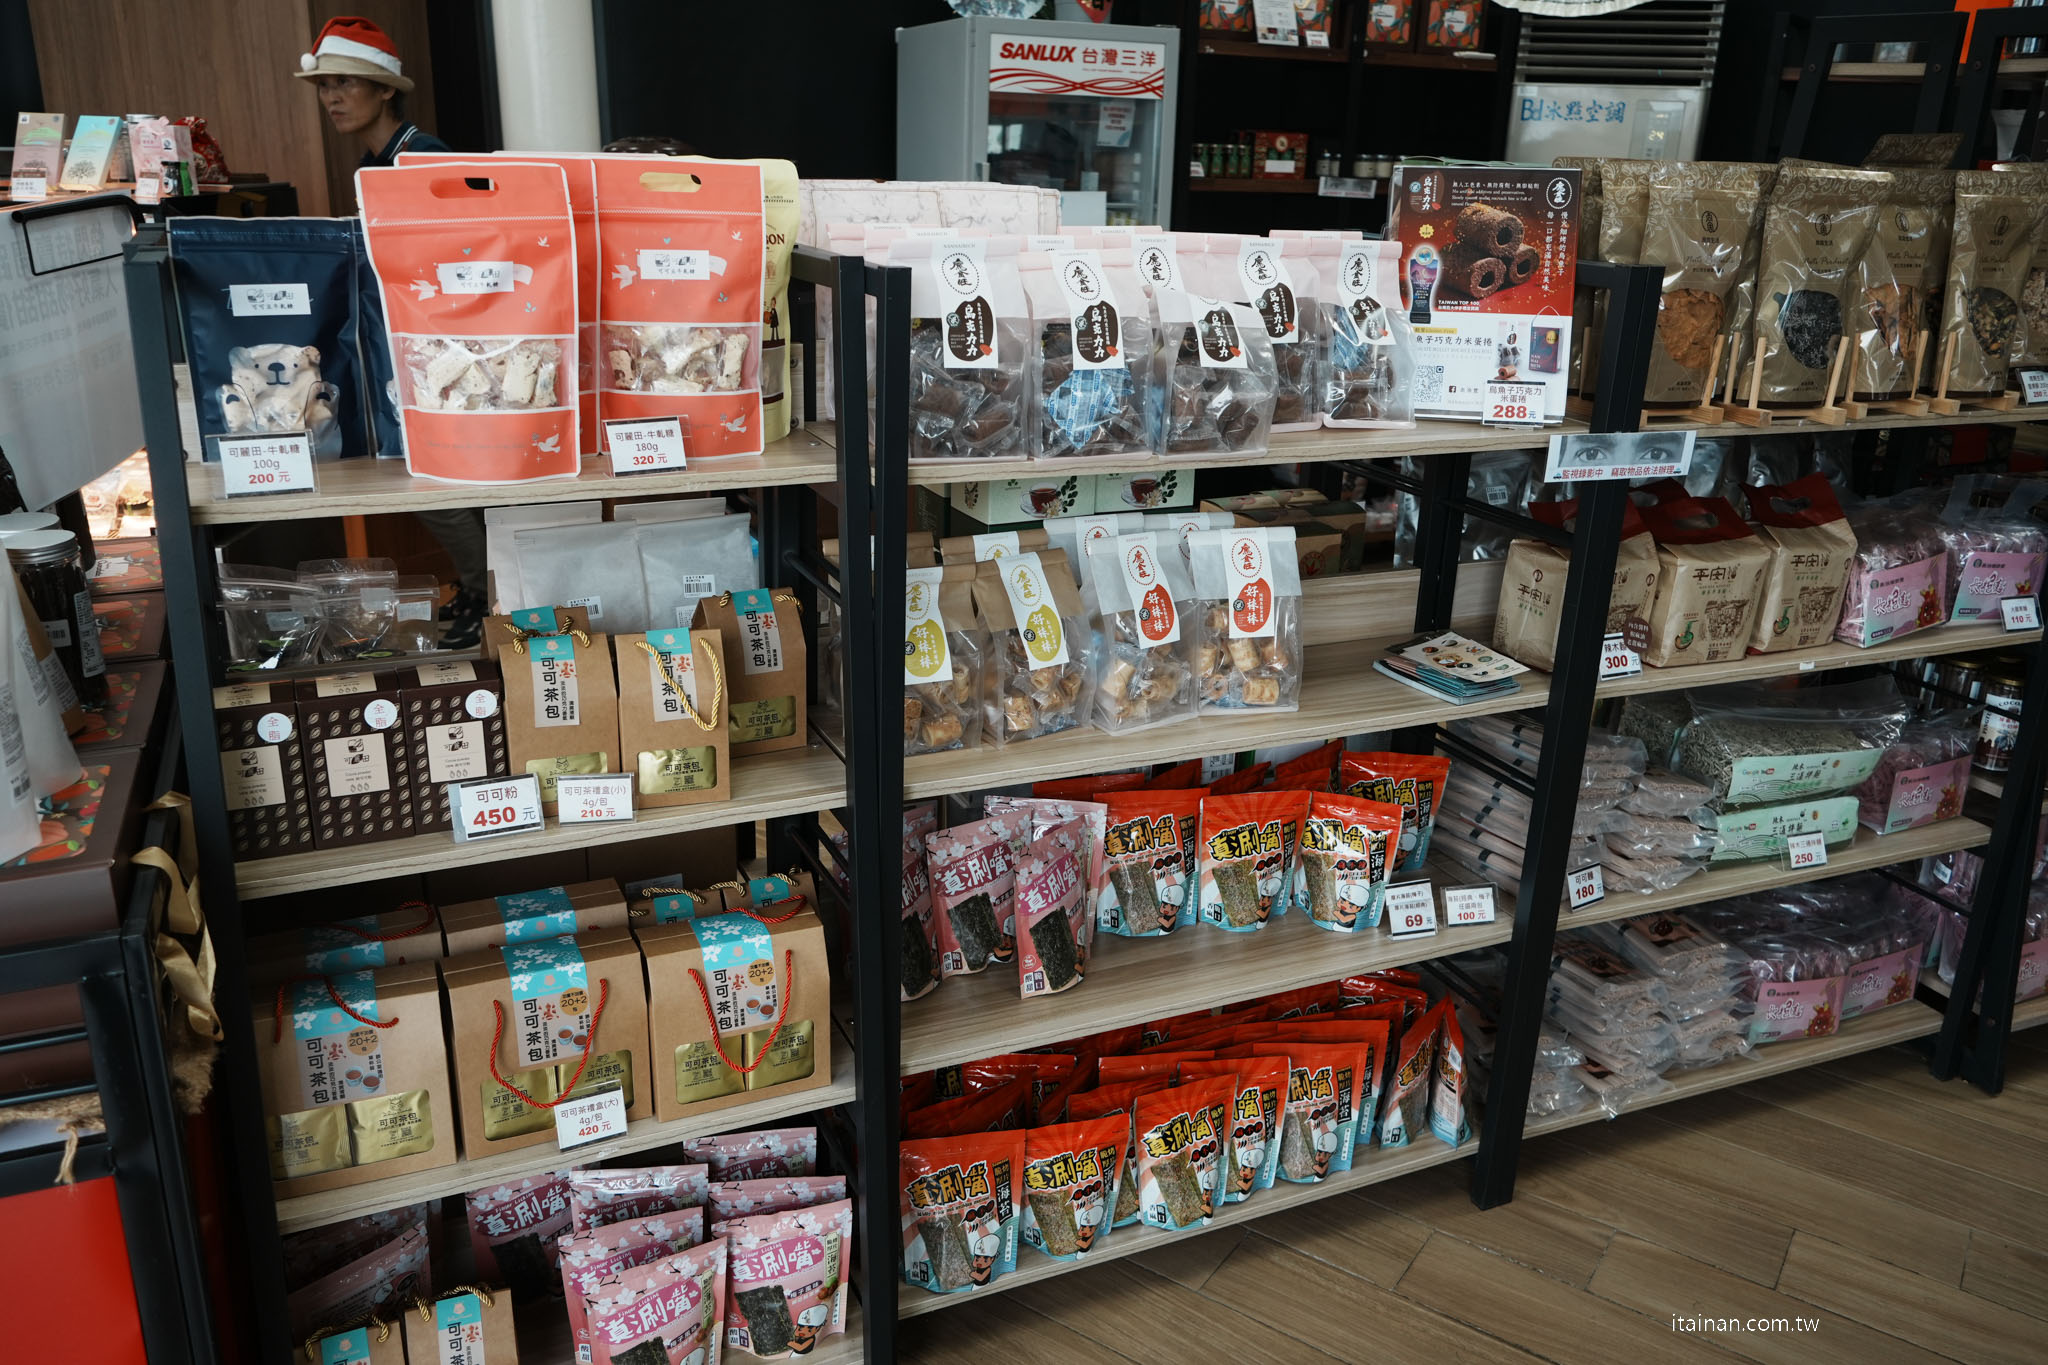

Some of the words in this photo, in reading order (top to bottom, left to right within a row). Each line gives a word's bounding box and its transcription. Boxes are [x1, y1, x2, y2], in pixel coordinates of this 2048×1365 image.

[1000, 42, 1076, 64] SANLUX
[1082, 48, 1156, 68] 台灣三洋
[1492, 405, 1528, 418] 288
[1528, 411, 1536, 419] 元
[636, 442, 658, 453] 180g
[253, 459, 280, 470] 100g
[633, 455, 654, 465] 320
[657, 453, 668, 464] 元
[248, 473, 275, 485] 200
[278, 471, 291, 483] 元
[1562, 468, 1603, 479] 監視錄影中
[1612, 466, 1674, 477] 竊取物品依法辦理
[1147, 593, 1164, 633] 好棒棒
[1244, 585, 1259, 625] 好棒棒
[2012, 616, 2024, 624] 110
[2026, 614, 2032, 622] 元
[744, 610, 766, 666] 可可茶包
[1031, 613, 1052, 653] 好棒棒
[912, 627, 933, 668] 好棒棒
[1605, 656, 1628, 668] 300
[1632, 656, 1639, 666] 元
[540, 658, 560, 718] 可可茶包
[659, 652, 678, 712] 可可茶包
[476, 693, 486, 716] 全脂
[374, 704, 387, 727] 全脂
[748, 714, 779, 724] 可可茶包
[268, 716, 280, 740] 全脂
[665, 762, 700, 772] 可可茶包
[476, 786, 518, 802] 可可粉
[564, 785, 626, 796] 可可茶禮盒(小)
[581, 809, 602, 818] 210
[606, 807, 616, 817] 元
[582, 798, 608, 808] 4g/包
[473, 806, 516, 827] 450
[523, 807, 536, 820] 元
[1105, 815, 1175, 856] 真涮嘴
[1212, 823, 1280, 859] 真涮嘴
[1795, 853, 1813, 864] 250
[1816, 853, 1823, 862] 元
[940, 847, 1008, 895] 真涮嘴
[1575, 874, 1594, 883] 可可麵
[902, 863, 928, 907] 涮嘴
[1024, 860, 1078, 913] 真涮嘴
[1576, 884, 1594, 899] 180
[1406, 914, 1422, 926] 69
[1458, 912, 1475, 920] 100
[1478, 910, 1486, 920] 元
[750, 967, 774, 978] 20+2
[561, 997, 587, 1008] 20+2
[714, 969, 732, 1030] 可可茶包
[522, 998, 543, 1062] 可可茶包
[350, 1035, 377, 1046] 20+2
[774, 1035, 804, 1047] 可可茶包
[306, 1038, 330, 1104] 可可茶包
[588, 1064, 620, 1078] 可可茶包
[684, 1055, 718, 1068] 可可茶包
[1290, 1068, 1332, 1102] 涮嘴
[560, 1098, 619, 1118] 可可茶禮盒(大)
[380, 1112, 418, 1127] 可可茶包
[579, 1112, 602, 1125] 4g/包
[579, 1125, 599, 1136] 420
[602, 1121, 612, 1131] 元
[1146, 1111, 1211, 1157] 真涮嘴
[1026, 1149, 1098, 1189] 真涮嘴
[910, 1163, 988, 1208] 真涮嘴
[514, 1192, 534, 1204] Licking
[484, 1185, 566, 1235] 真涮嘴
[762, 1243, 782, 1253] Licking
[590, 1262, 608, 1270] Finger
[610, 1252, 631, 1263] Licking
[731, 1239, 814, 1281] 真涮嘴
[827, 1255, 838, 1274] 海苔
[604, 1284, 691, 1344] 真涮嘴
[618, 1307, 636, 1318] Finger
[638, 1294, 659, 1306] Licking
[448, 1322, 464, 1365] 可可茶
